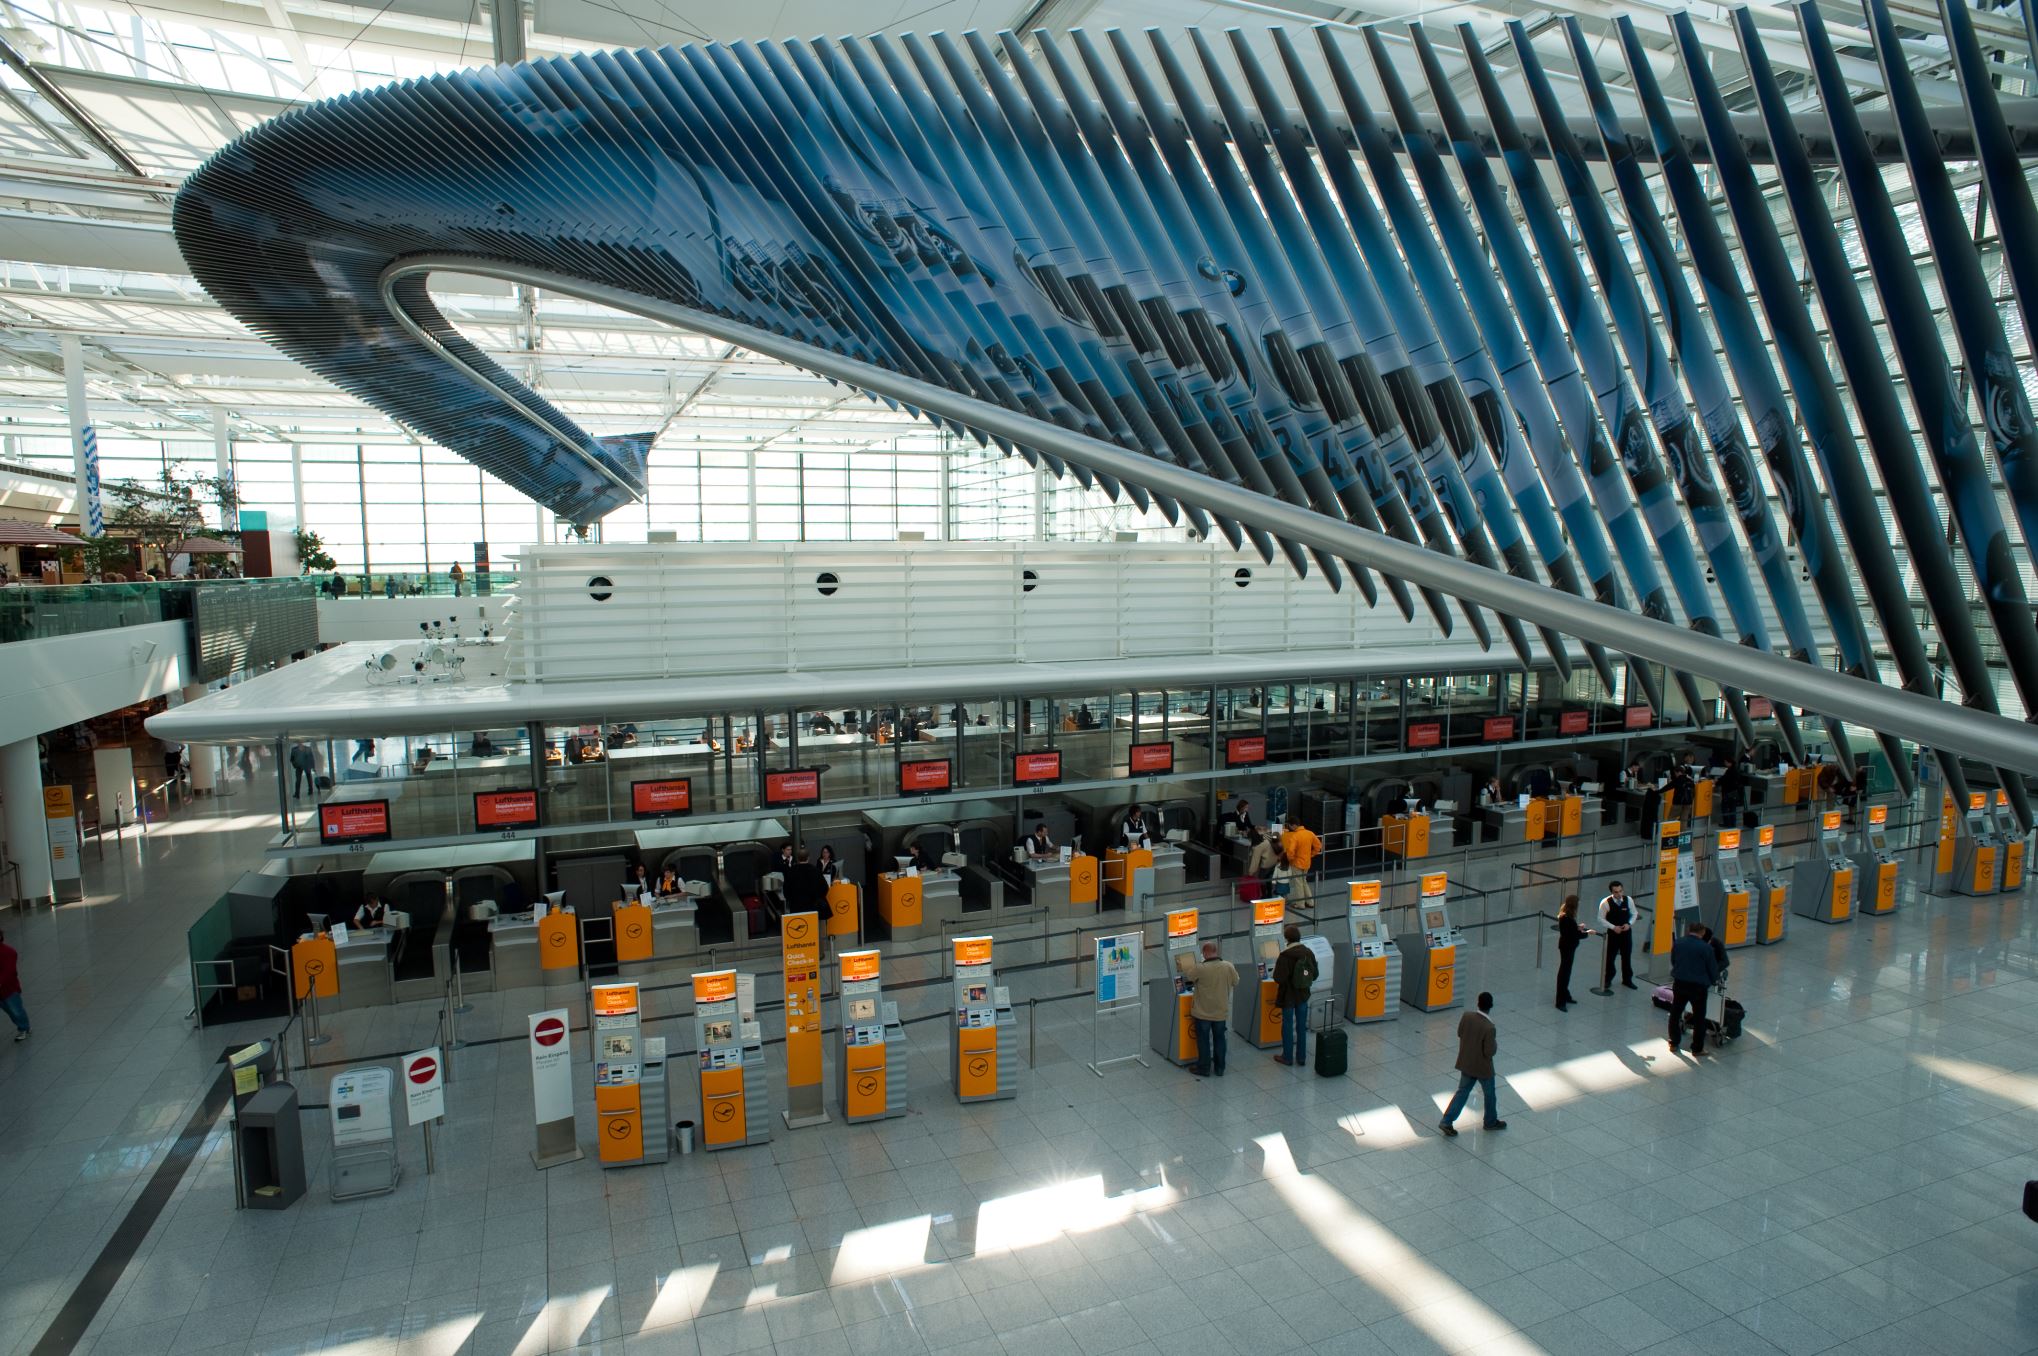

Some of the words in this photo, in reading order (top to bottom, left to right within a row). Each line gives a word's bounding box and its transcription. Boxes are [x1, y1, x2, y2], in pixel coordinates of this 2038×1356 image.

[781, 775, 815, 783] Lufthansa
[650, 784, 686, 792] Lufthansa
[494, 795, 533, 803] Lufthansa
[341, 807, 383, 816] Lufthansa
[349, 843, 365, 853] 445
[786, 941, 816, 949] Lufthansa
